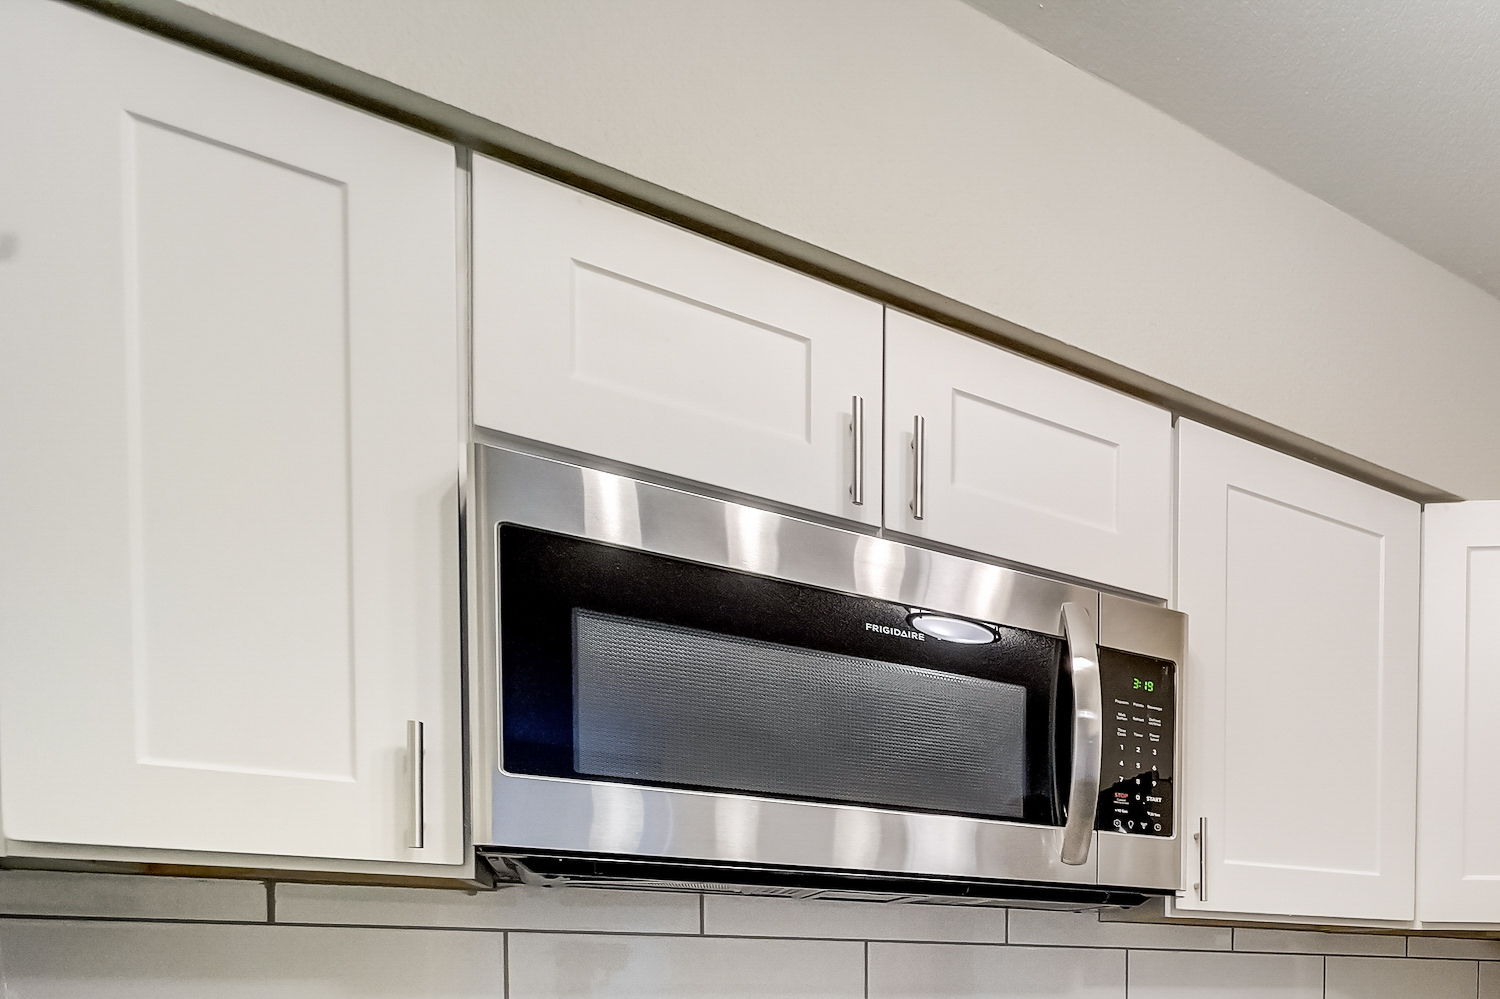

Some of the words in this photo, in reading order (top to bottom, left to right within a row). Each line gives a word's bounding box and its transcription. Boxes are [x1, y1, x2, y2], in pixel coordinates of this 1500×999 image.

[865, 623, 926, 641] FRIGIDAIRE
[1133, 678, 1154, 692] 3:19
[1146, 795, 1163, 803] START
